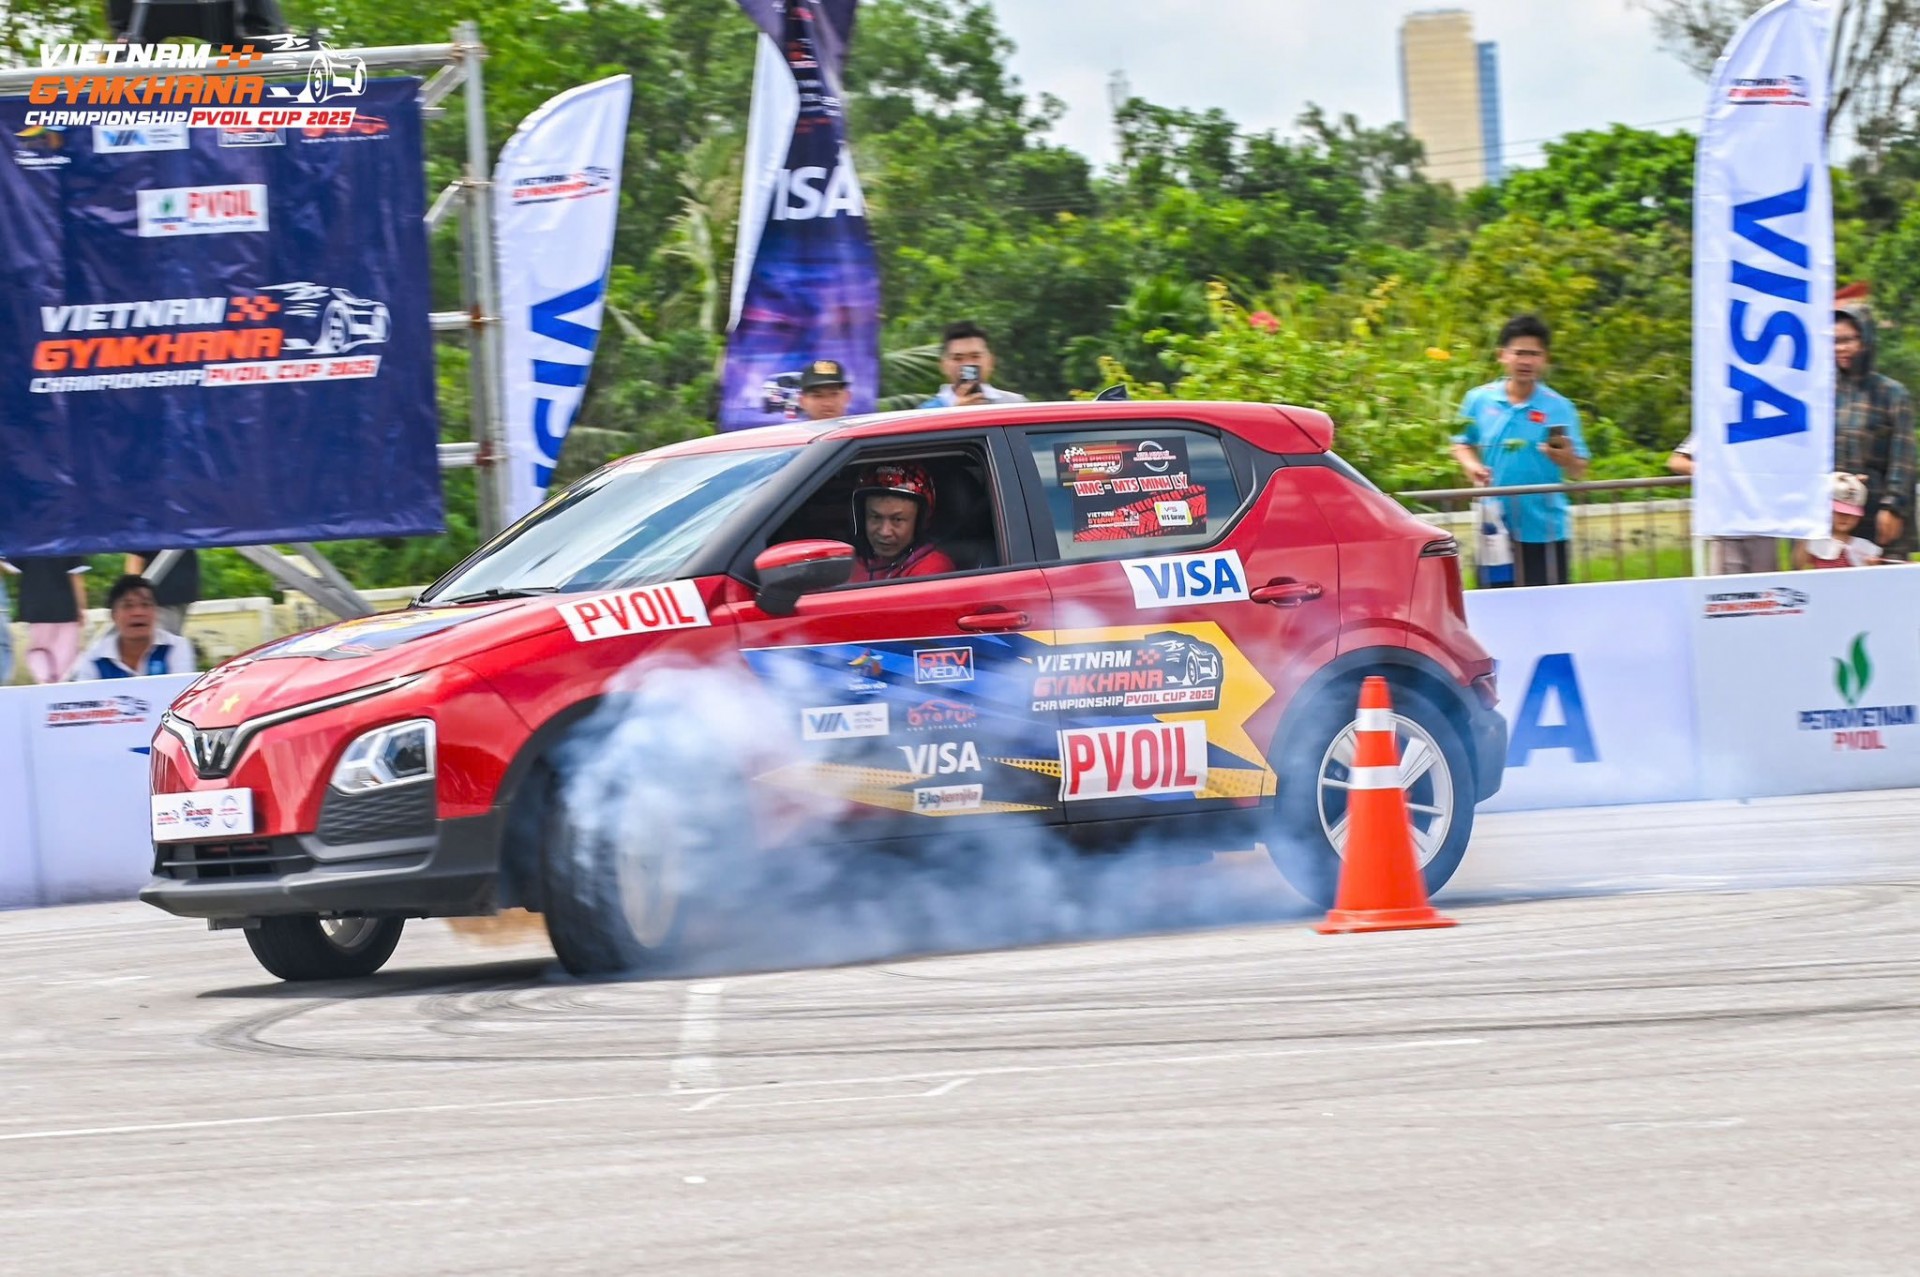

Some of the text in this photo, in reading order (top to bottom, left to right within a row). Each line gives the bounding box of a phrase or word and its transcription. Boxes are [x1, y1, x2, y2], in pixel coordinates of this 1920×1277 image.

[772, 166, 864, 220] ISA
[40, 297, 228, 333] VIETNAM
[1726, 164, 1812, 444] VISA
[33, 328, 284, 371] GYMKHANA
[29, 368, 202, 394] CHAMPIONSHIP
[208, 365, 272, 384] PVOIL
[278, 362, 320, 380] CUP
[1073, 480, 1105, 496] HMC
[1111, 478, 1140, 494] MTS
[1138, 475, 1173, 491] MINH
[1132, 558, 1241, 599] VISA
[573, 587, 697, 636] PVOIL
[920, 665, 971, 679] MEDIA
[1037, 650, 1132, 673] VIETNAM
[1032, 689, 1215, 712] CHAMPIONSHIP PVOIL CUP 2025
[1033, 669, 1163, 698] GYMKHANA
[1833, 729, 1888, 751] PVOIL
[896, 741, 982, 775] VISA
[1067, 727, 1198, 796] PVOIL
